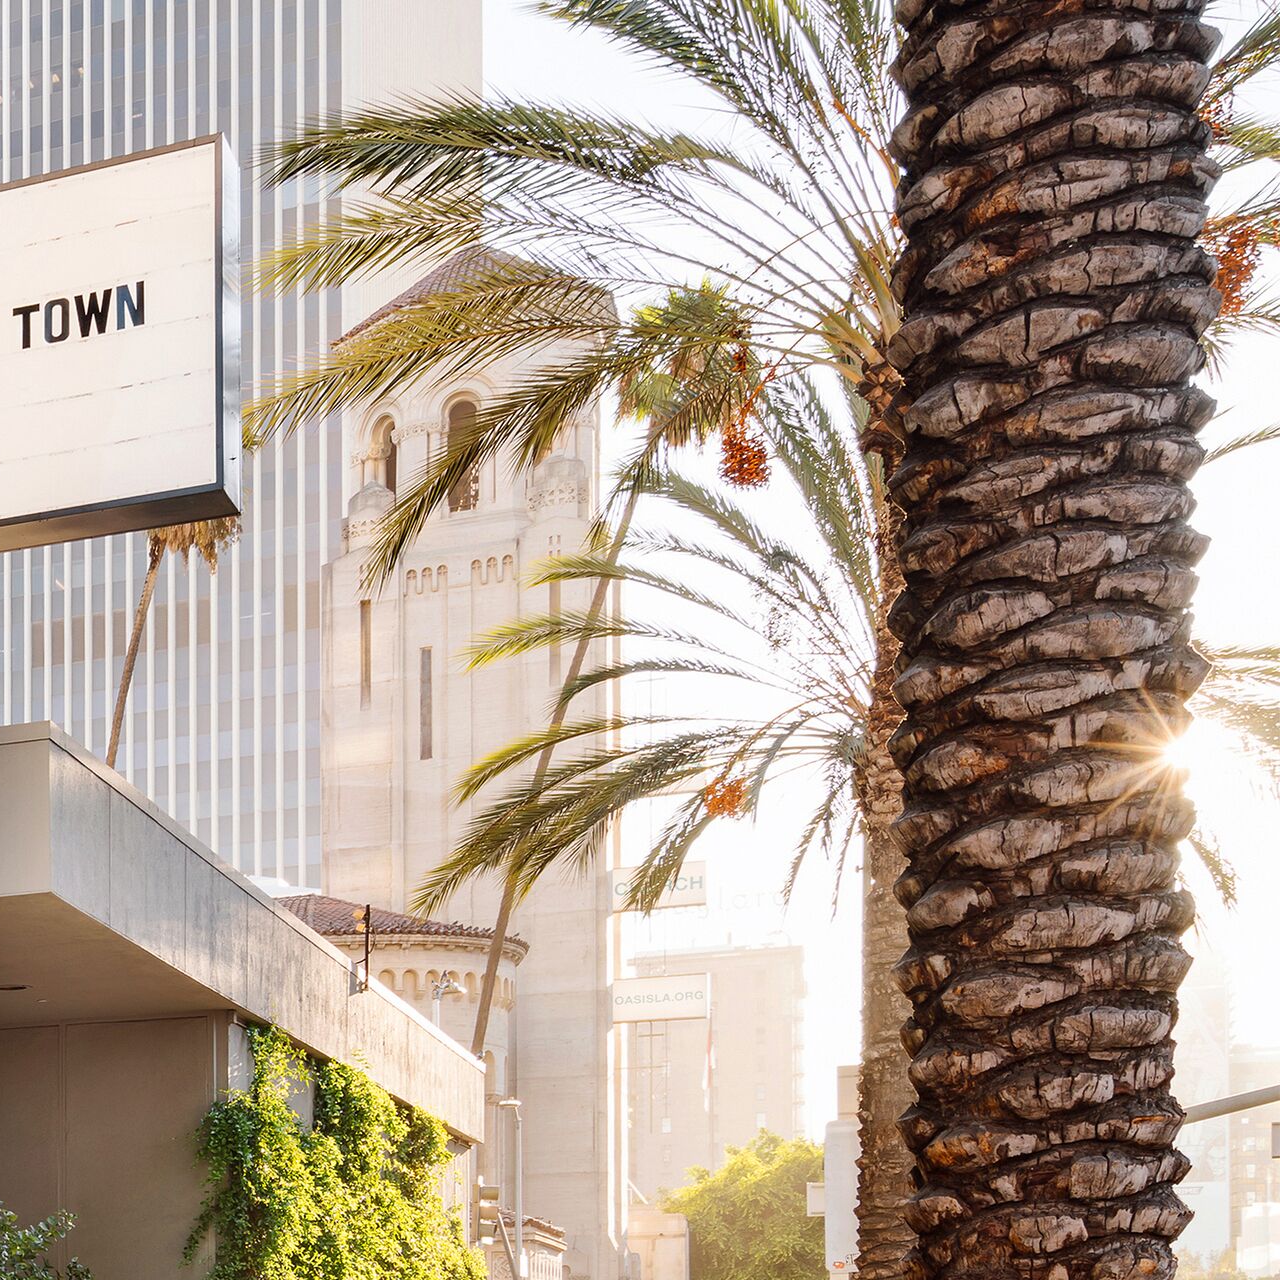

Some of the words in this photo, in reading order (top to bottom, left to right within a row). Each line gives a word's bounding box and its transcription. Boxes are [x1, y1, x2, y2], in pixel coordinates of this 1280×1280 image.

[13, 280, 147, 350] TOWN
[614, 875, 704, 896] CCH
[614, 990, 704, 1006] OASISLA.ORG
